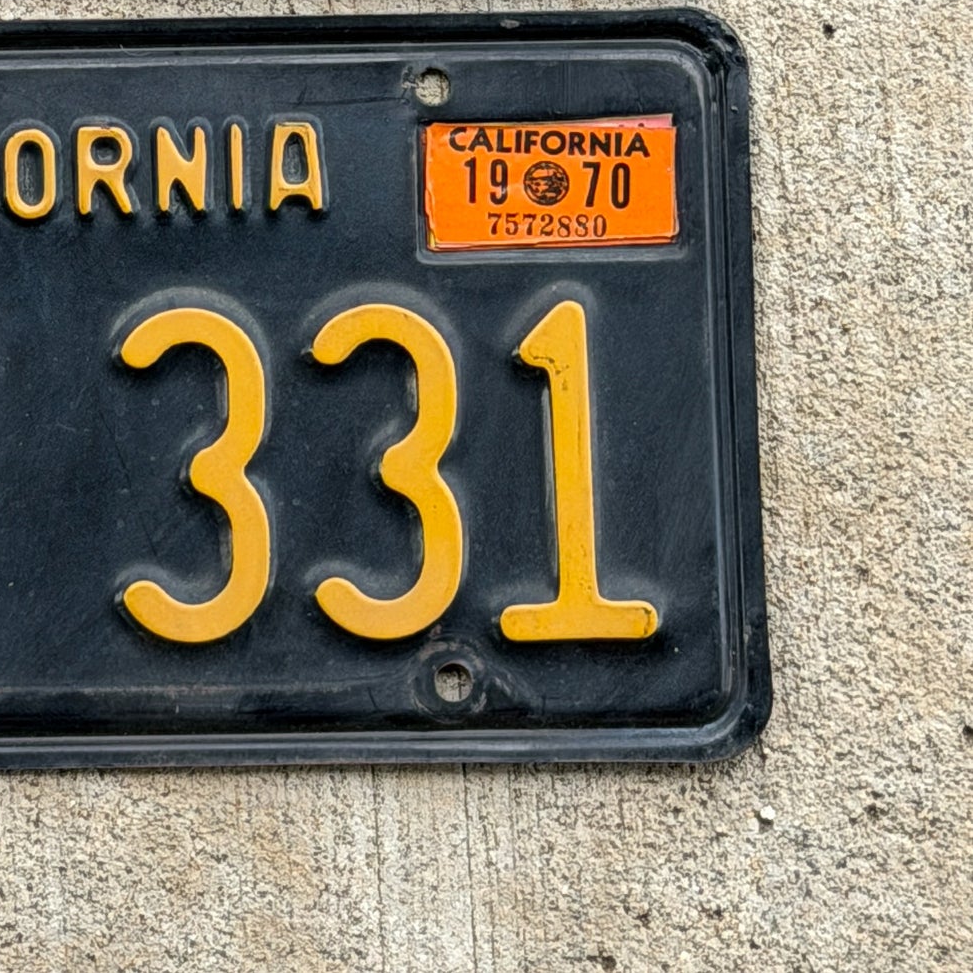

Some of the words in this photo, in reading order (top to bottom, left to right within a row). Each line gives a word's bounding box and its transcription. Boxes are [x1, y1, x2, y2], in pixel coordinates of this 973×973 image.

[448, 126, 650, 158] CALIFORNIA
[464, 156, 509, 206] 19
[582, 161, 631, 209] 70
[487, 212, 608, 238] 7572880
[120, 299, 661, 645] 331
